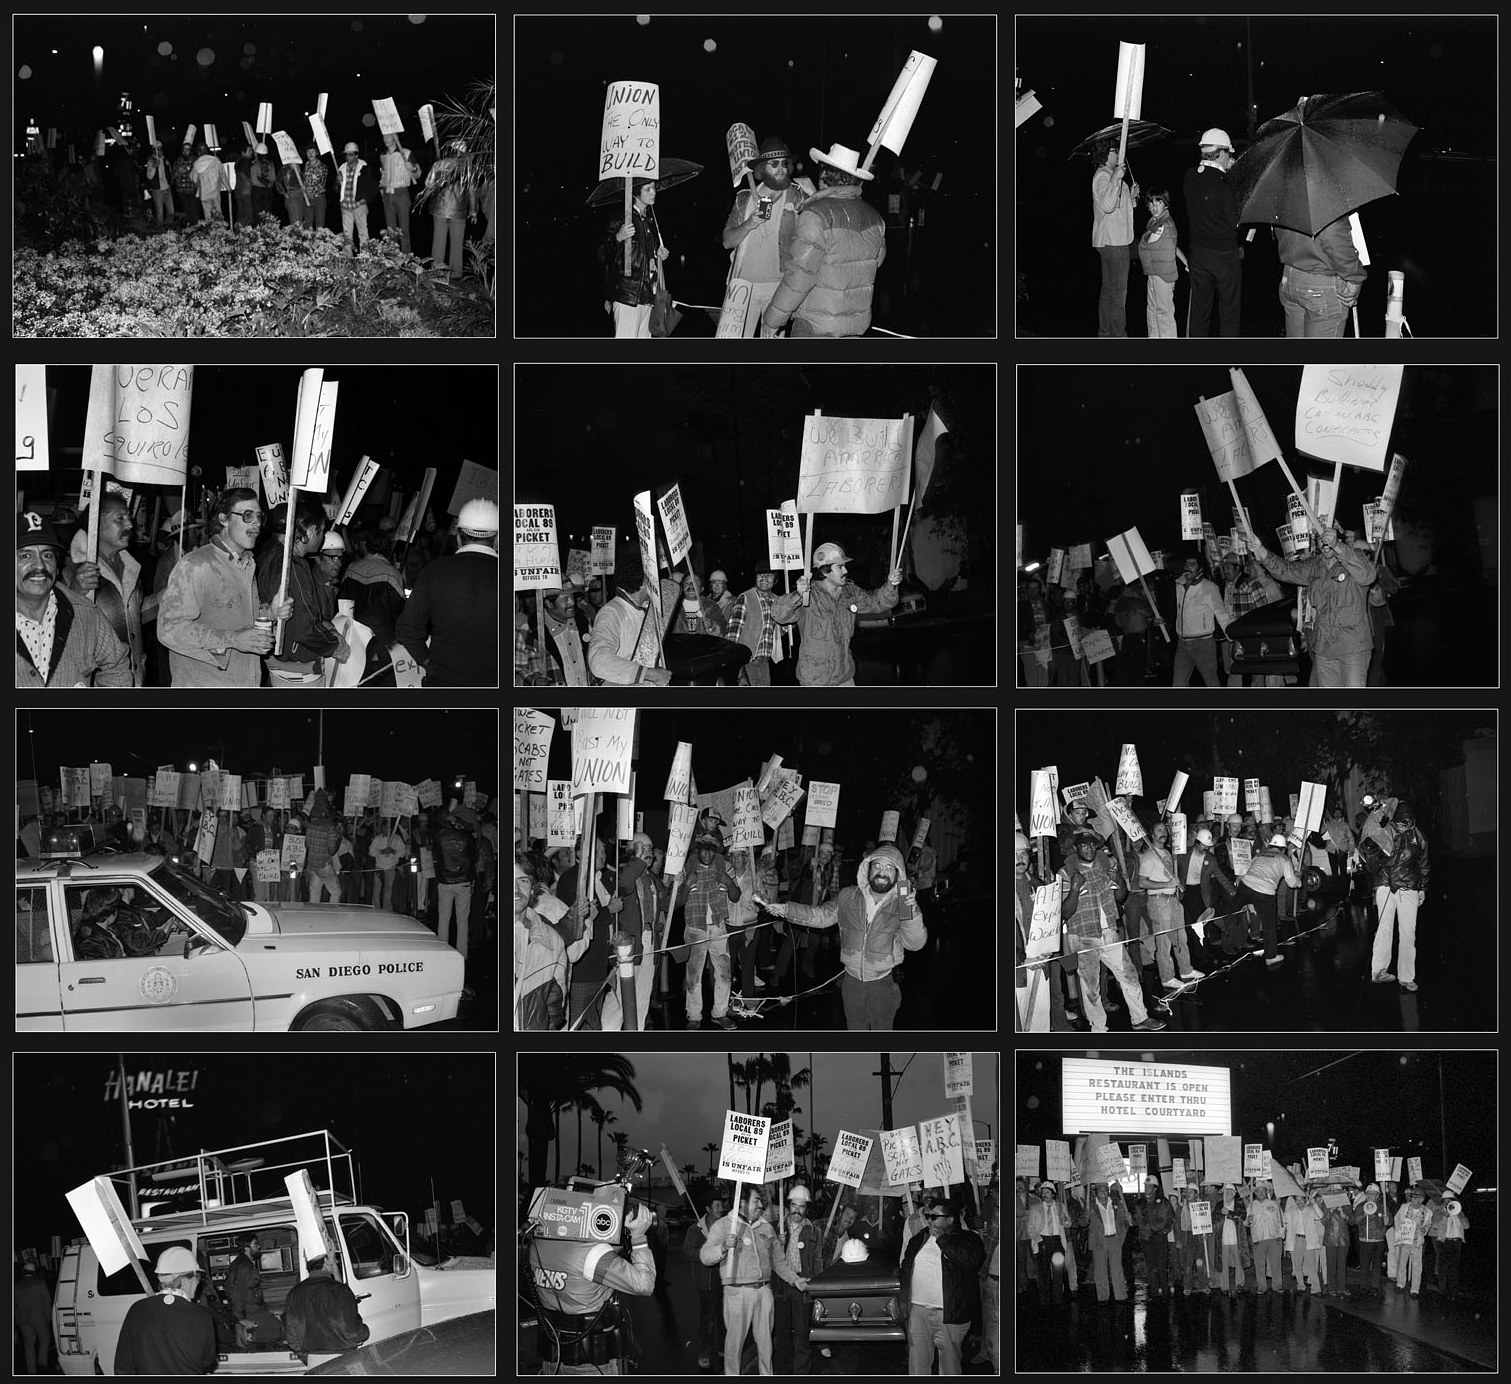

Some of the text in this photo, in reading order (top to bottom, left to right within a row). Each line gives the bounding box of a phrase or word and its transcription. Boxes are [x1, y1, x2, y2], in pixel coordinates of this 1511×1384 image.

[628, 108, 659, 129] ONLY
[637, 138, 655, 148] TO
[601, 152, 656, 174] BUILD
[669, 509, 682, 525] PICKET
[543, 519, 553, 528] 89
[516, 533, 550, 543] PICKET
[521, 567, 560, 576] UNFAIR
[519, 757, 536, 767] NOT
[573, 757, 629, 788] UNION
[811, 784, 838, 793] STOP
[1067, 784, 1088, 794] LABORERS
[1070, 791, 1083, 799] LOCAL
[296, 961, 424, 980] SAN DIEGO POLICE
[1114, 1066, 1188, 1079] THE ISLANDS
[104, 1069, 199, 1101] HANALEI
[1088, 1078, 1208, 1092] RESTAURANT IS OPEN
[128, 1099, 194, 1109] HOTEL
[1095, 1092, 1206, 1105] PLEASE ENTER THRU
[1101, 1105, 1206, 1118] HOTEL COURTYARD
[730, 1114, 766, 1128] LABORERS
[730, 1123, 763, 1136] LOCAL 89
[924, 1118, 955, 1137] HEY
[733, 1134, 757, 1146] PICKET
[841, 1133, 869, 1147] LABORERS
[841, 1140, 866, 1152] LOCAL 89
[842, 1148, 862, 1159] PICKET
[731, 1162, 761, 1173] UNFAIR
[556, 1205, 578, 1214] KGTV
[543, 1212, 581, 1224] INSTA-CAM
[596, 1217, 611, 1227] abc
[534, 1267, 568, 1291] NEWS
